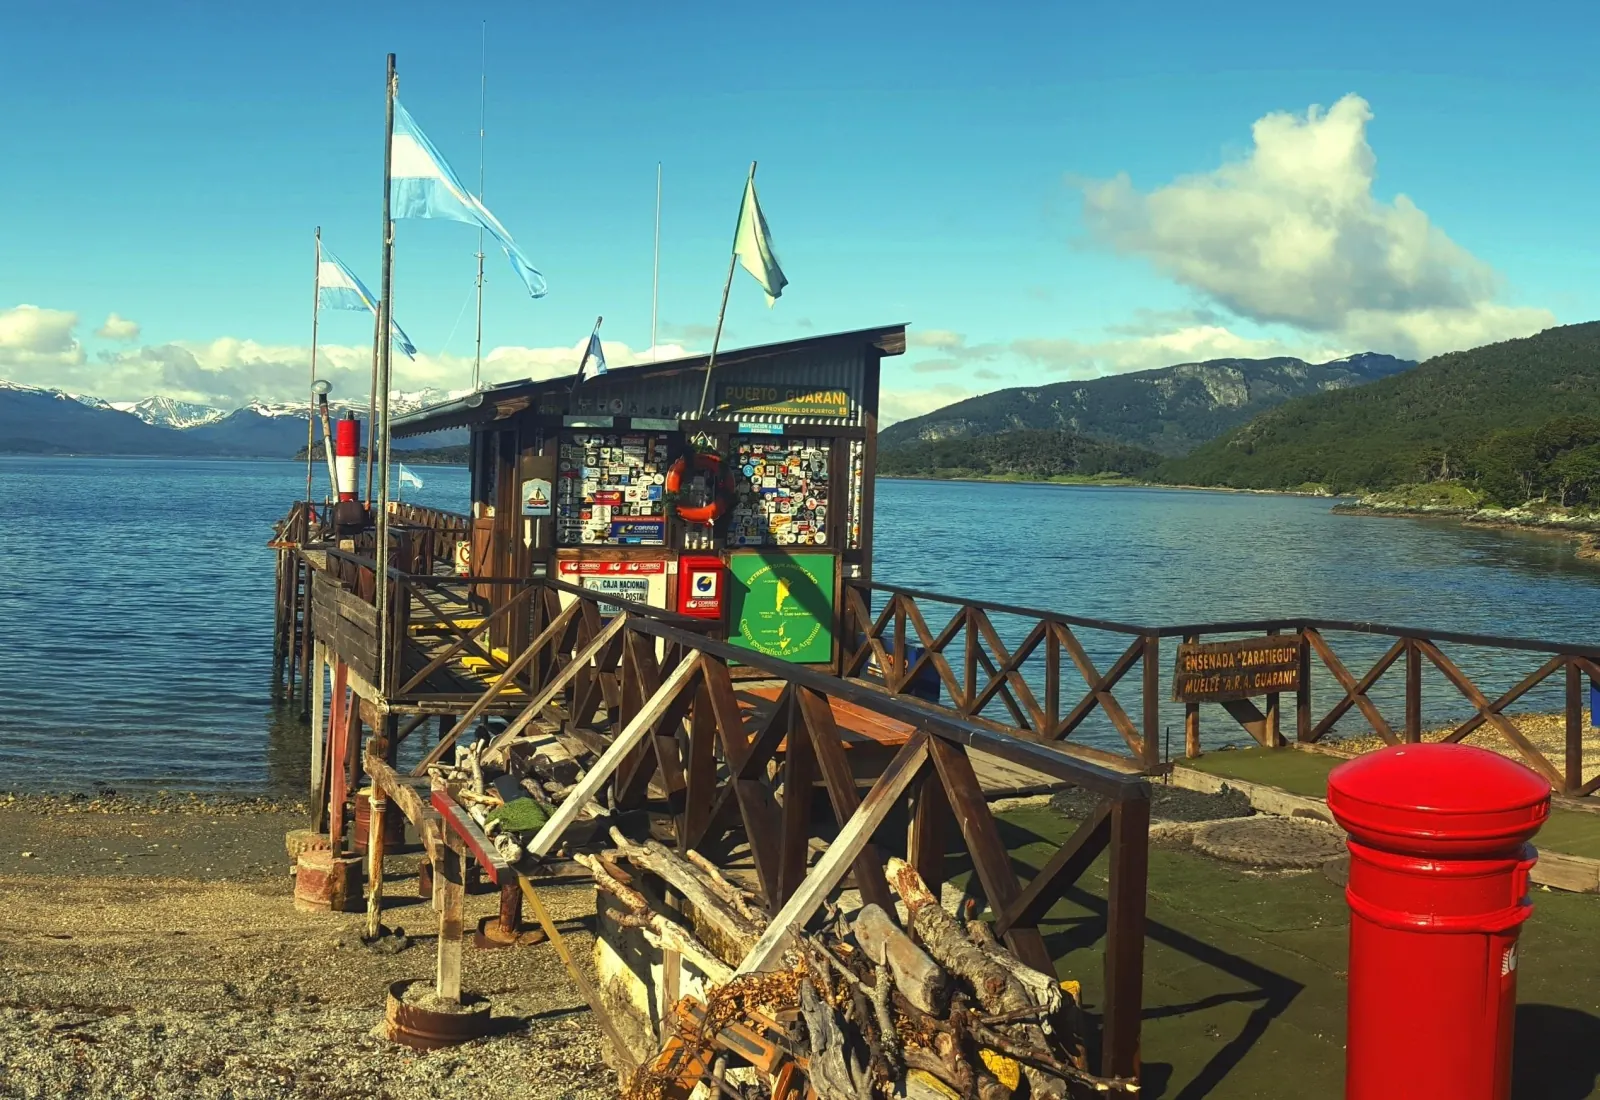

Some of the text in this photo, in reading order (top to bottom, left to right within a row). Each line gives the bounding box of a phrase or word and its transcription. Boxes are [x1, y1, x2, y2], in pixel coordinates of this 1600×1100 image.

[725, 386, 846, 405] PUERTO GUARANI
[746, 564, 772, 585] EXTREMO
[602, 580, 646, 589] CAJA NACIONAL
[625, 592, 646, 601] POSTAL
[741, 618, 753, 641] Centro
[783, 648, 791, 656] de
[799, 622, 821, 649] Argentina
[1186, 653, 1235, 670] ENSENADA
[1185, 676, 1220, 693] MUELLE
